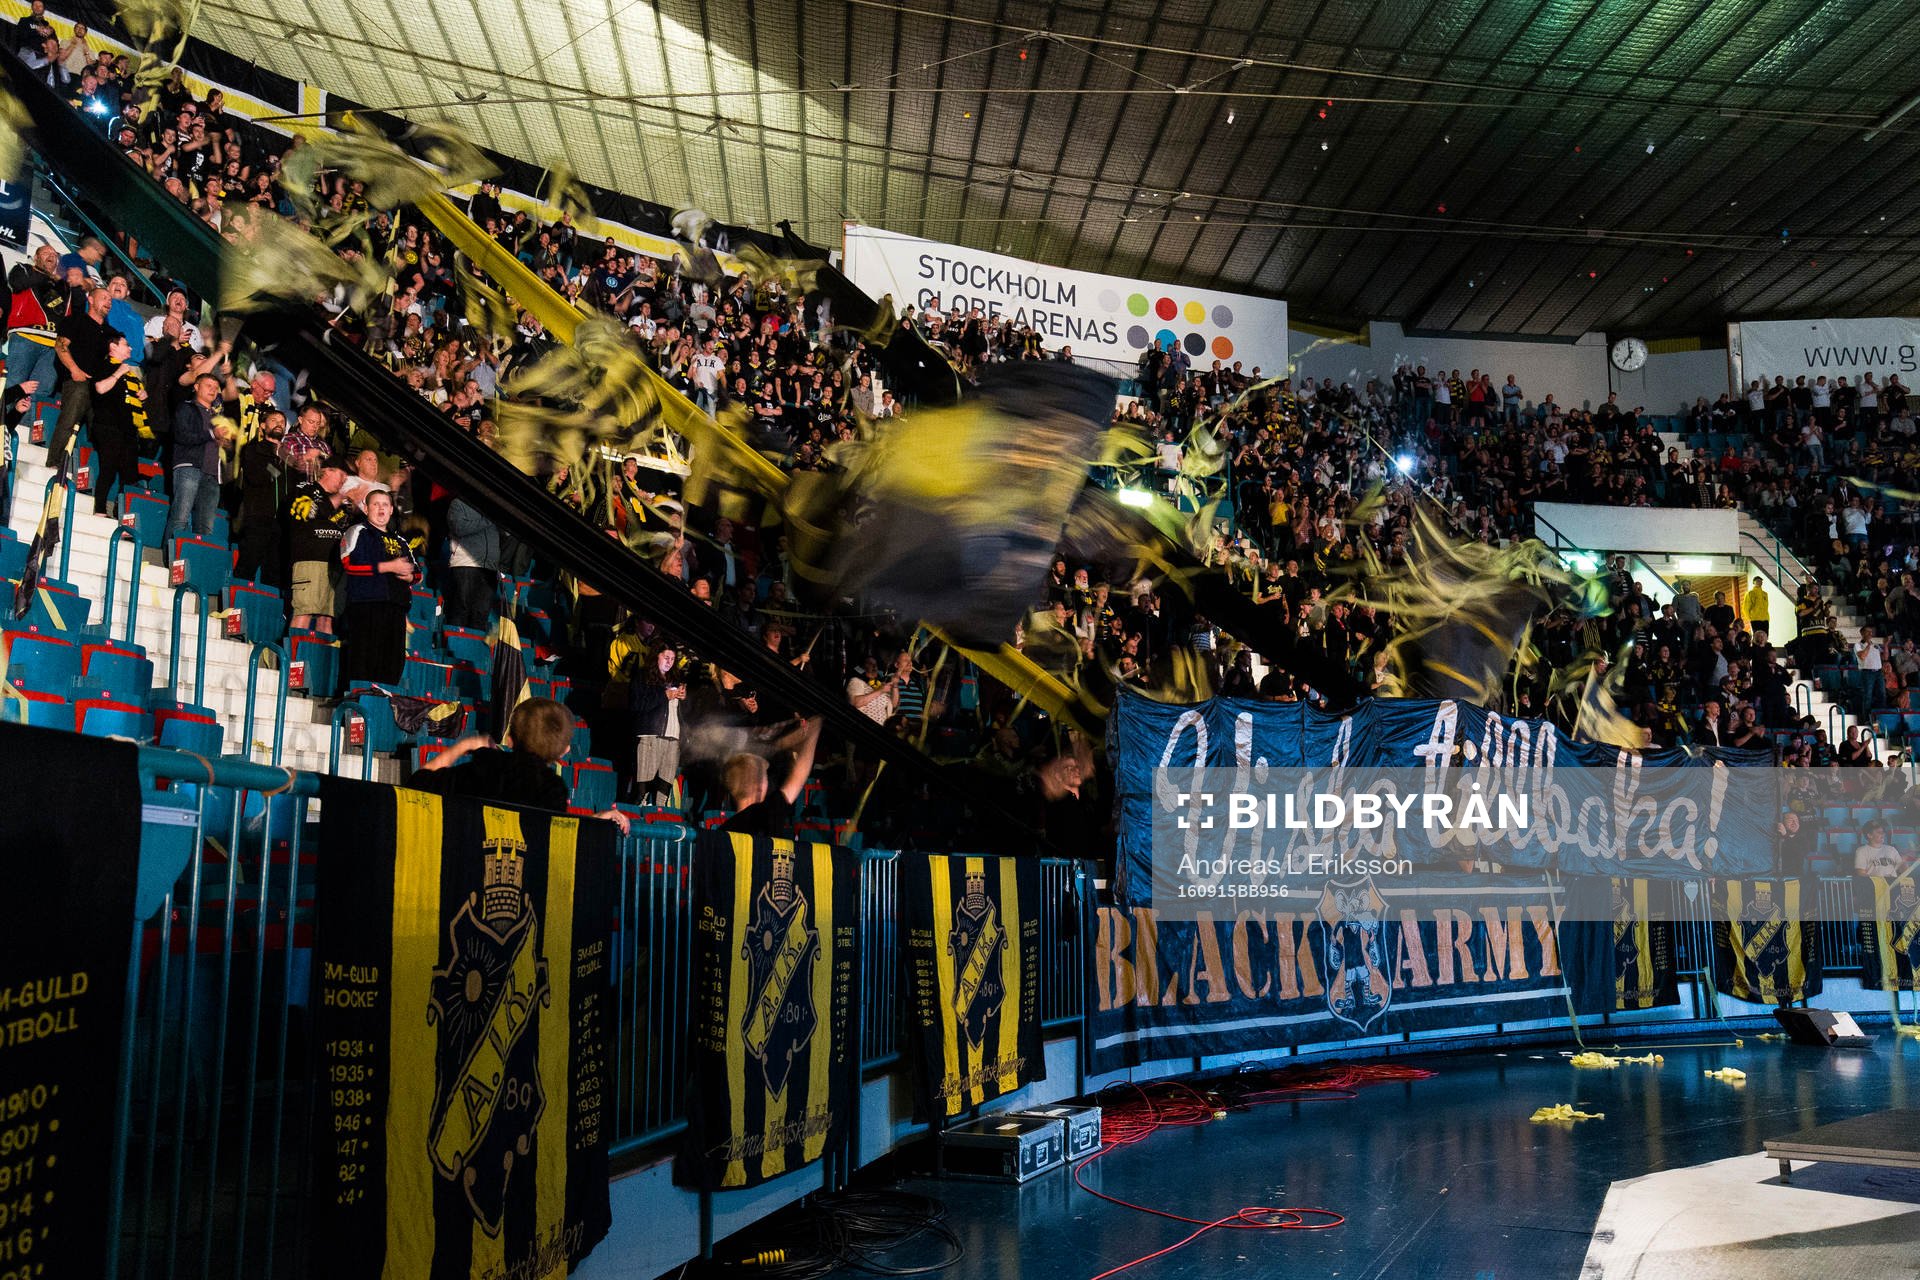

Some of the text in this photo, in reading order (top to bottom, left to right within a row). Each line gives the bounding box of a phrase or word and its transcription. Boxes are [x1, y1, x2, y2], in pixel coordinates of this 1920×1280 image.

[918, 254, 1076, 307] STOCKHOLM
[1013, 306, 1119, 345] ARENAS
[314, 529, 342, 538] TOYOTA
[1413, 700, 1730, 871] tillbaka!
[1096, 906, 1325, 1011] BLACK
[1392, 905, 1566, 989] ARMY
[329, 1065, 365, 1082] 1935
